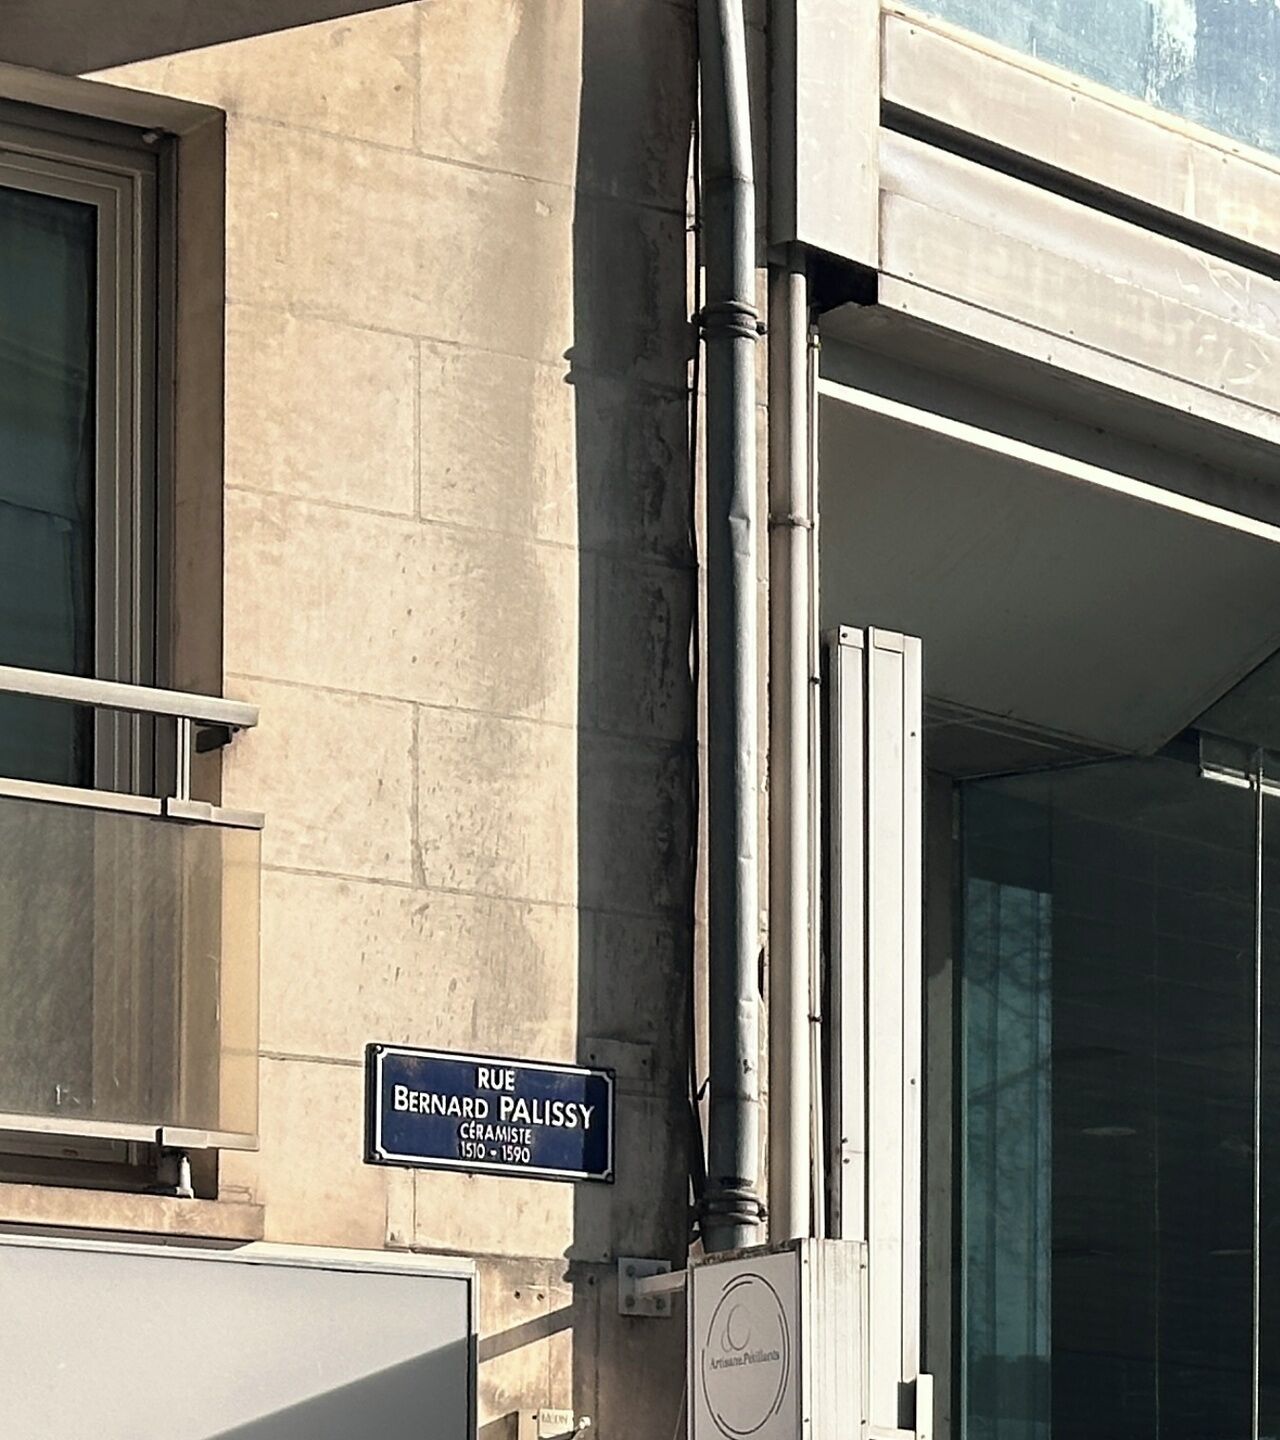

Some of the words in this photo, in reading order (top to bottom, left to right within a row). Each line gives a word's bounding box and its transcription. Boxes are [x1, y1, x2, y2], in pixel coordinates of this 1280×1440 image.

[478, 1067, 515, 1092] RUE
[394, 1085, 489, 1119] BERNARD
[499, 1096, 595, 1130] PALISSY
[460, 1121, 533, 1145] CÉRAMISTE
[461, 1141, 485, 1160] 1510
[502, 1144, 531, 1163] 1590
